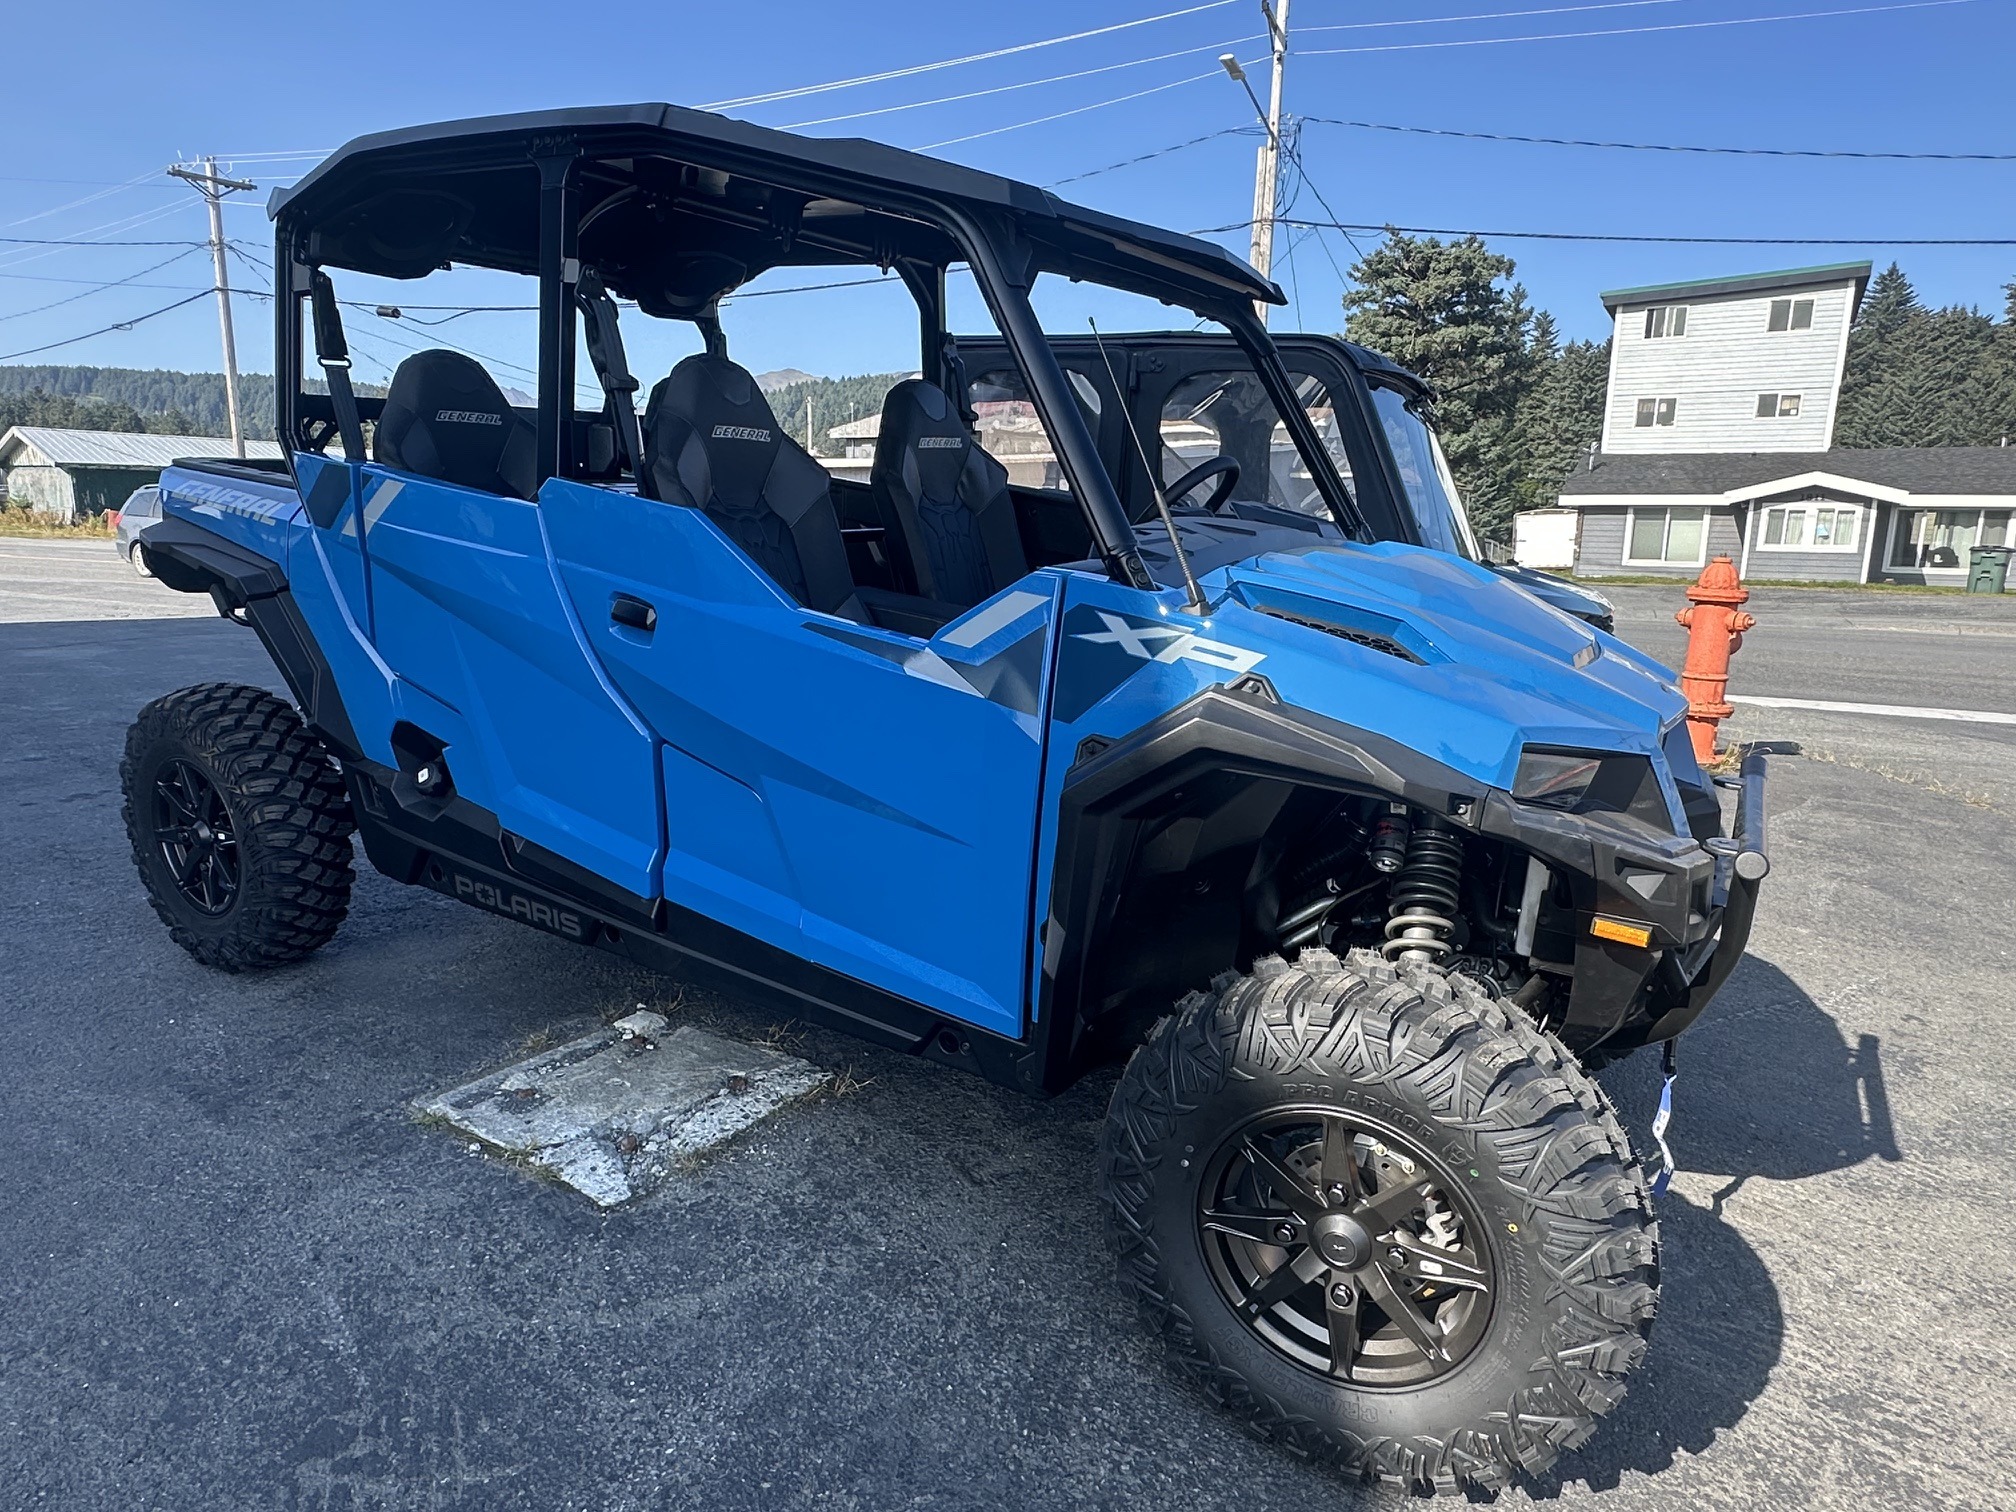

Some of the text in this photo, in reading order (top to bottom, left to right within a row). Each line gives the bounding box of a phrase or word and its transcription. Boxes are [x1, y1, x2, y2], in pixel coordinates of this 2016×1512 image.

[435, 409, 503, 426] GENERAL
[711, 425, 771, 442] GENERAL
[918, 437, 963, 449] GENERAL
[171, 480, 287, 526] GENERAL
[1067, 610, 1268, 673] XP
[454, 873, 582, 937] POLARIS
[1281, 1083, 1438, 1141] PRO ARMOR
[1258, 1362, 1378, 1424] CRAWLER
